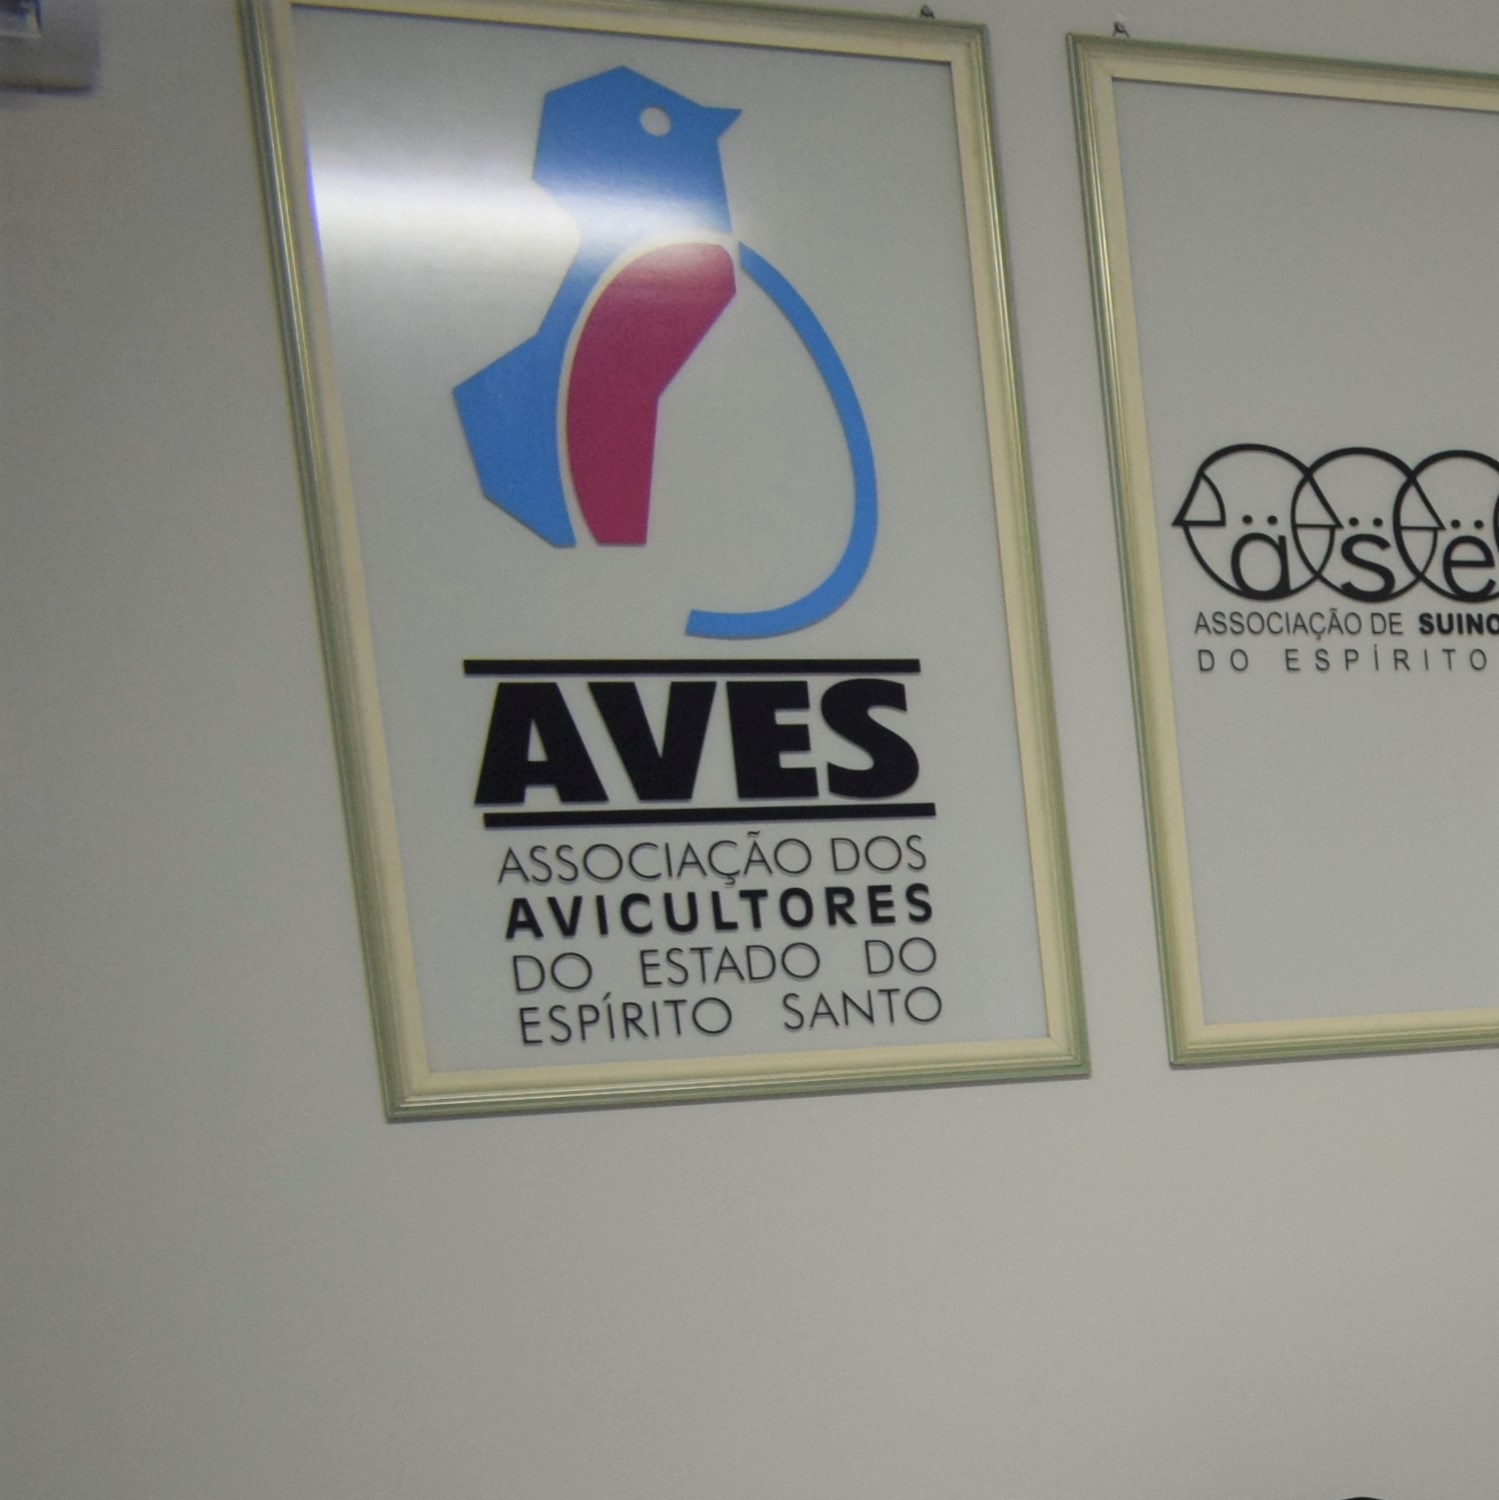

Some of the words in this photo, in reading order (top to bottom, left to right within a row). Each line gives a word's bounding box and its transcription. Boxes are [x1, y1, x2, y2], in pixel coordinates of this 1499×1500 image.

[1194, 607, 1362, 640] ASSOCIAÇÃO
[1370, 612, 1404, 635] DE
[1198, 648, 1249, 672] DO
[1285, 643, 1488, 671] ESPÍRITO
[474, 678, 919, 806] AVES
[498, 831, 811, 885] ASSOCIAÇÃO
[831, 835, 927, 873] DOS
[505, 883, 933, 940] AVICULTORES
[512, 952, 593, 992] DO
[640, 943, 820, 987] ESTADO
[864, 937, 937, 976] DO
[519, 992, 733, 1046] ESPÍRITO
[782, 986, 943, 1031] SANTO
